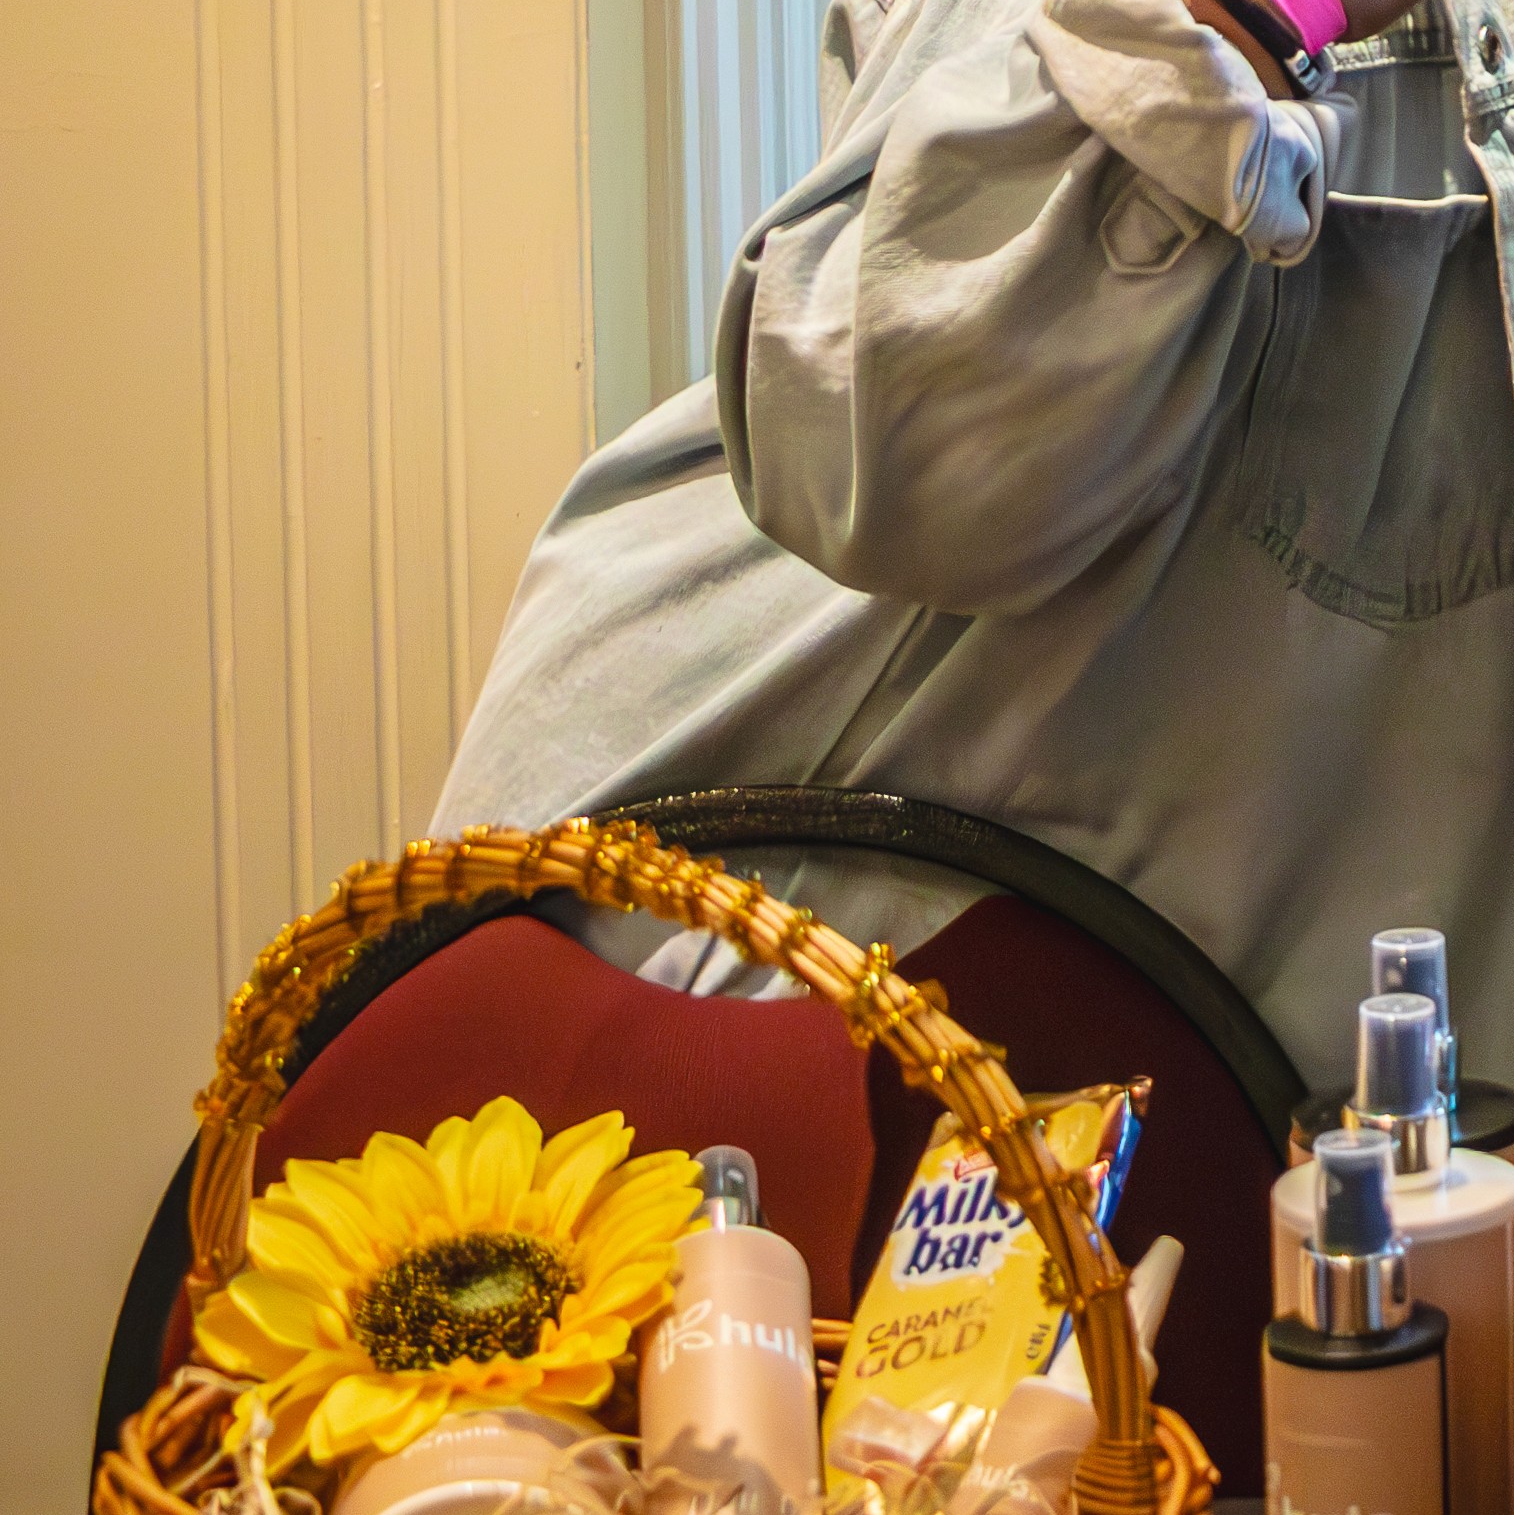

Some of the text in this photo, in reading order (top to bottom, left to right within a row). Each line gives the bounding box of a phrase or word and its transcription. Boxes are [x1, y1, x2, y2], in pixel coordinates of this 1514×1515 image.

[896, 1175, 1027, 1232] Milk
[902, 1228, 1002, 1276] bar
[856, 1321, 986, 1379] GOLD
